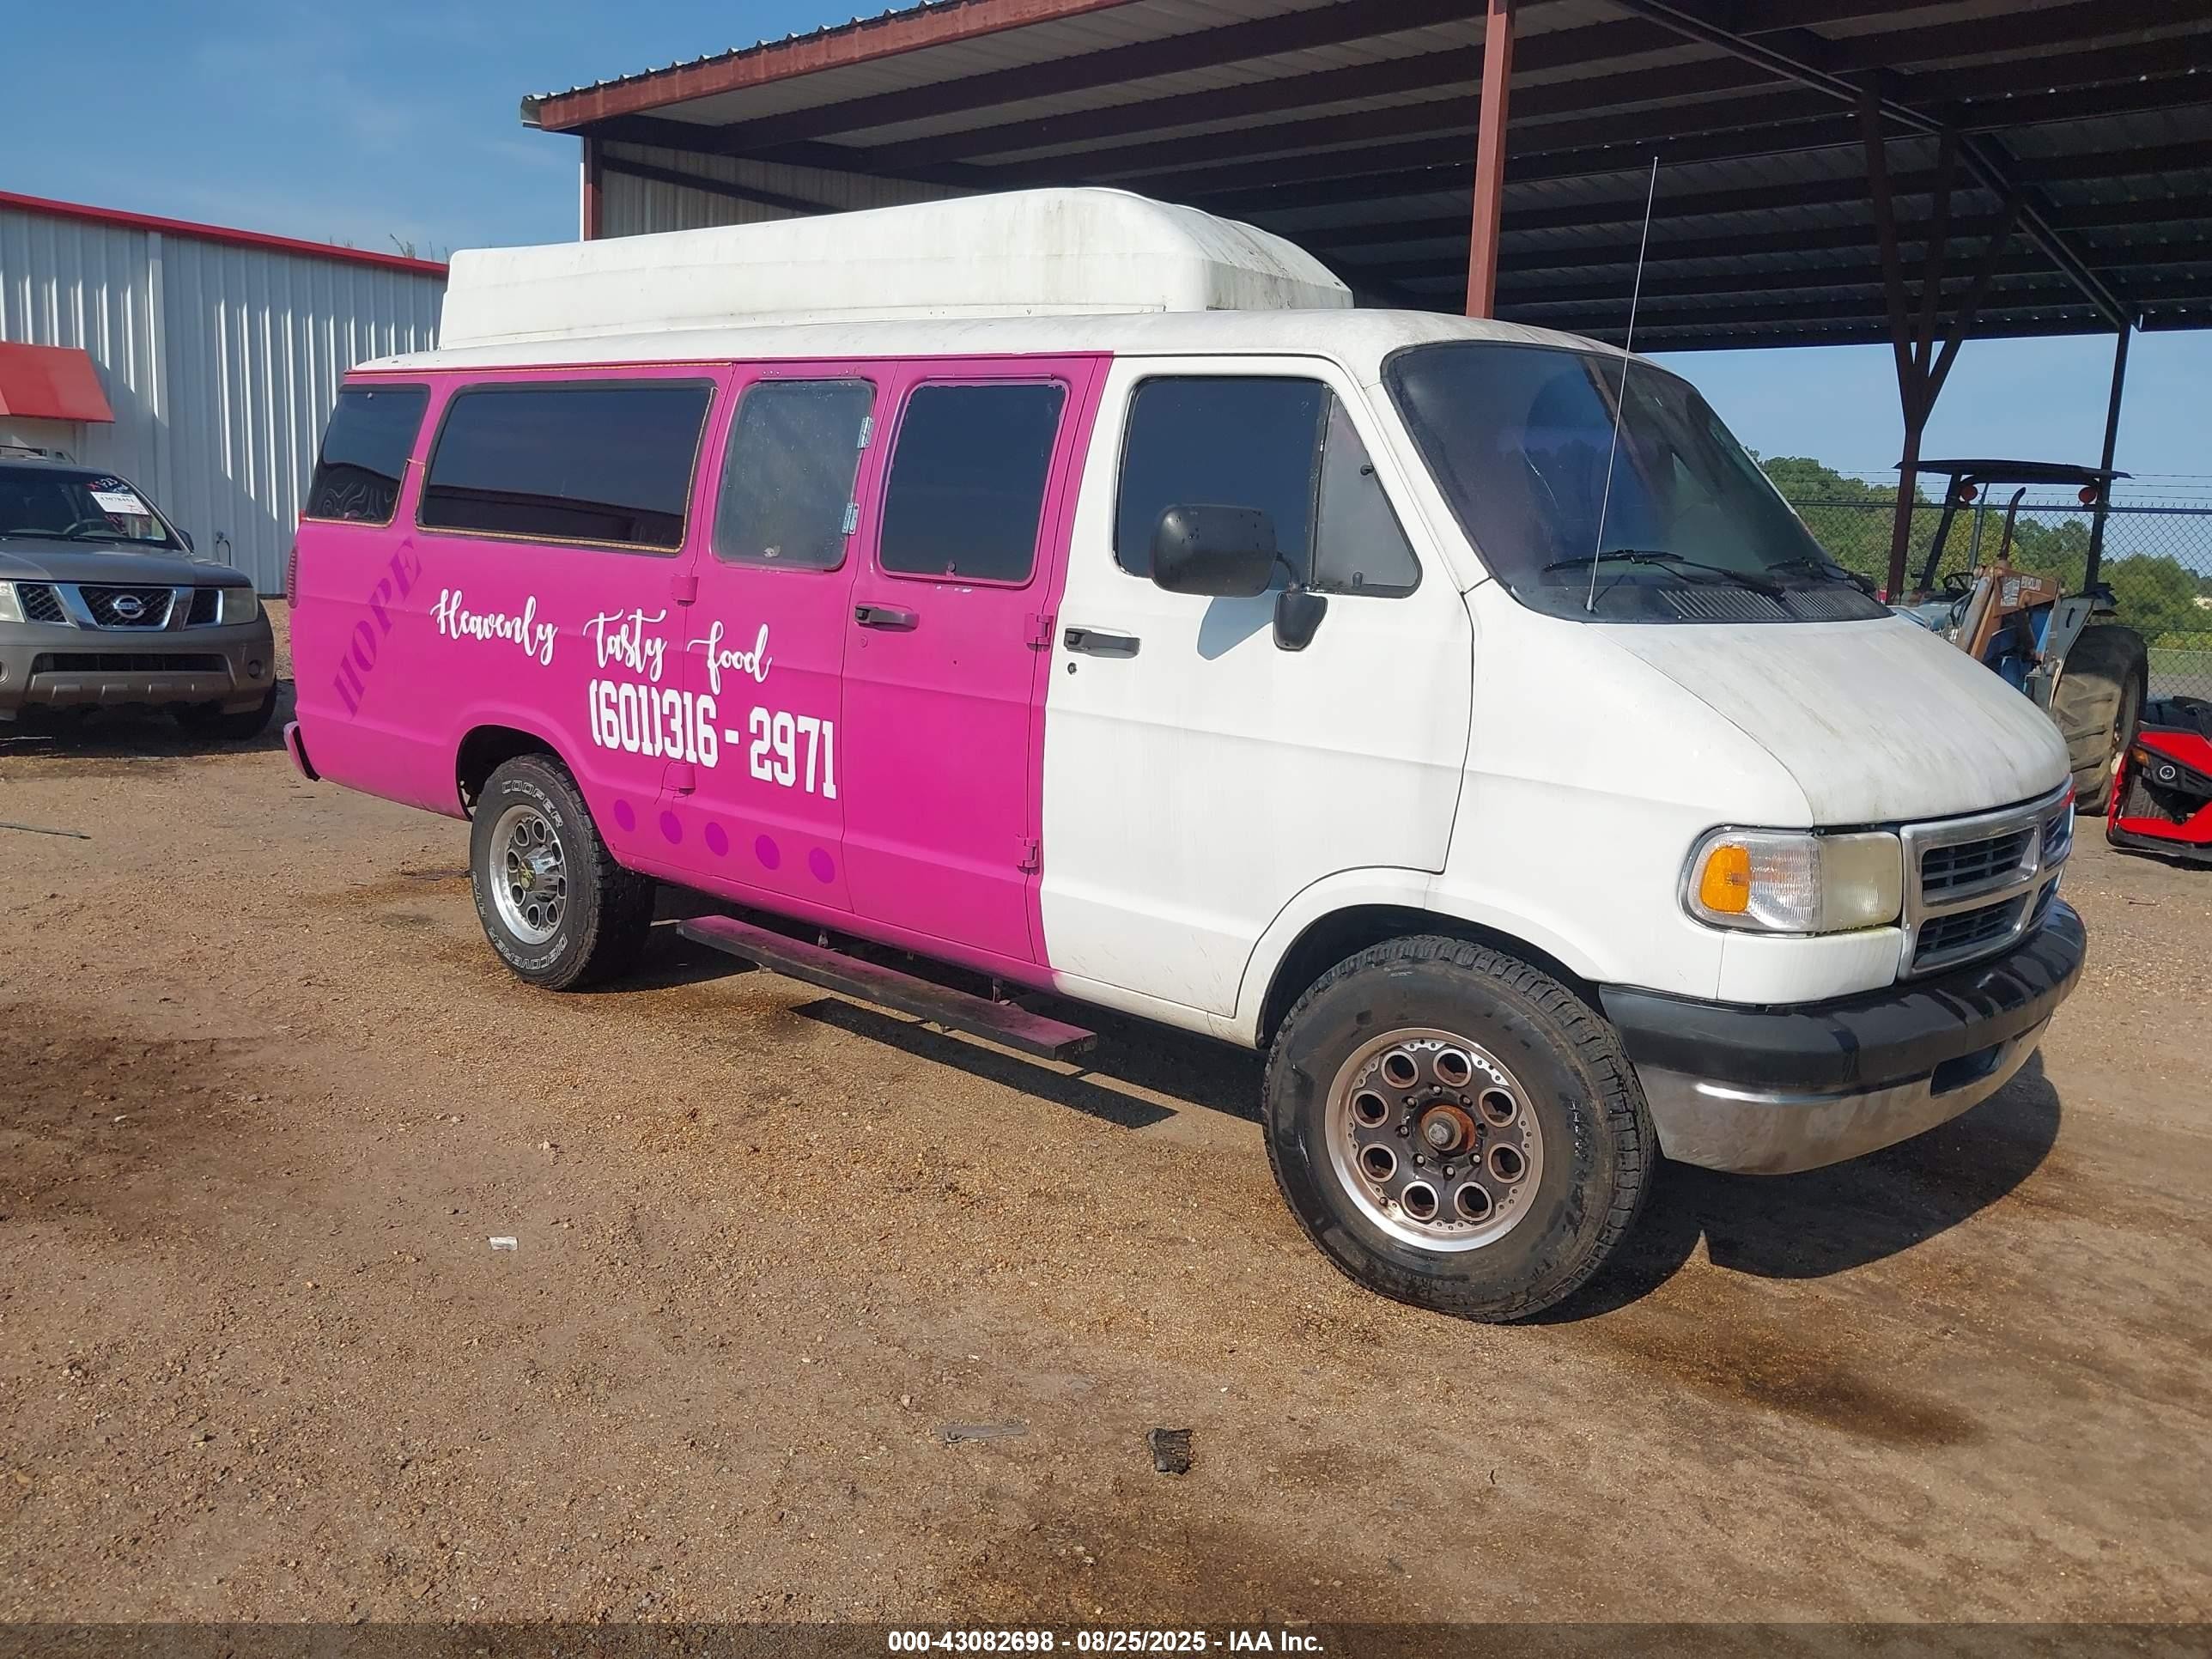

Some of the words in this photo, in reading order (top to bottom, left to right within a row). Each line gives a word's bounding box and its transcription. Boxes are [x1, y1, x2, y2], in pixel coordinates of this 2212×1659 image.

[333, 536, 422, 720] HOPE
[429, 588, 558, 665] Heavenly
[686, 620, 773, 695] food
[501, 780, 564, 828] COOPER
[488, 927, 568, 970] DISCOVERER
